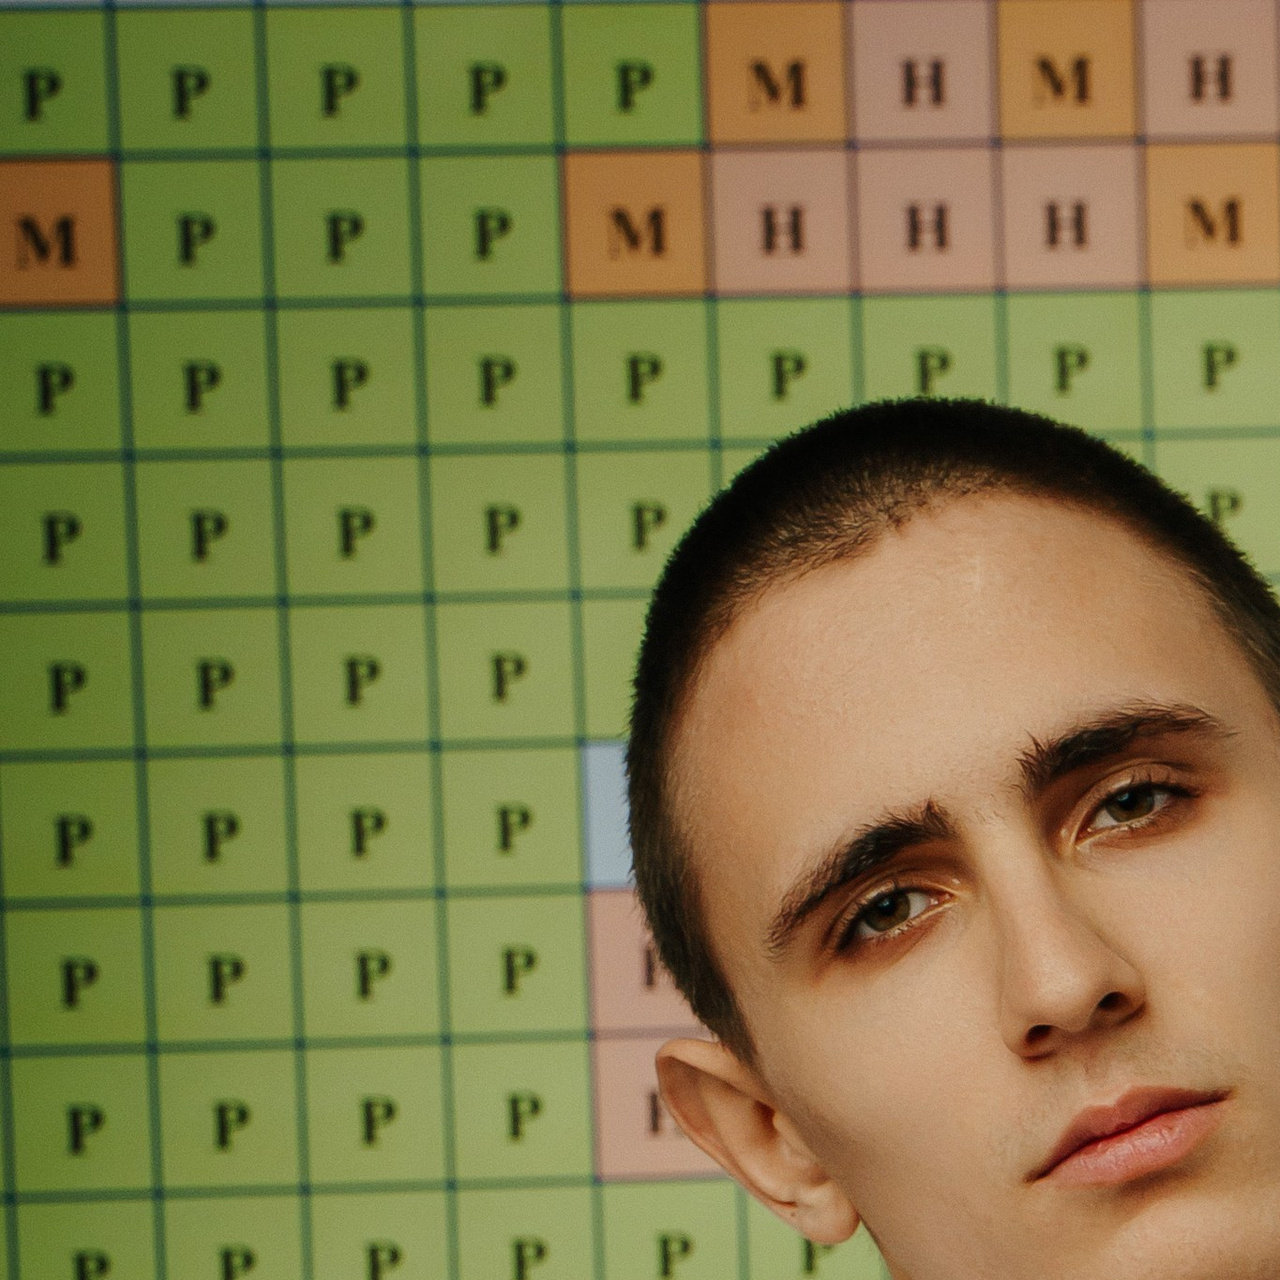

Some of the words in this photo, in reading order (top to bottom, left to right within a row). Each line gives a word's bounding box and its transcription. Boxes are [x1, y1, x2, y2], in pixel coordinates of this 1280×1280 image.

[21, 66, 64, 124] Р
[170, 65, 212, 121] Р
[467, 61, 509, 117] Р
[615, 59, 655, 114] Р
[749, 58, 807, 111] М
[901, 58, 946, 108] Н
[1035, 54, 1091, 106] М
[1188, 53, 1233, 103] Н
[15, 214, 78, 270] М
[176, 212, 217, 268] Р
[324, 210, 366, 265] Р
[473, 207, 513, 263] Р
[609, 205, 667, 258] М
[760, 205, 805, 255] Н
[905, 203, 949, 252] Н
[1044, 200, 1088, 249] Н
[1185, 195, 1243, 248] М
[34, 362, 76, 418] Р
[182, 360, 223, 415] Р
[330, 357, 371, 412] Р
[625, 352, 664, 405] Р
[770, 350, 808, 402] Р
[915, 348, 952, 394] Р
[1202, 343, 1238, 391] Р
[41, 511, 83, 568] Р
[189, 509, 230, 564] Р
[336, 507, 376, 560] Р
[630, 501, 668, 552] Р
[195, 658, 236, 712] Р
[343, 655, 382, 708] Р
[490, 652, 528, 703] Р
[201, 810, 241, 865] Р
[349, 807, 388, 859] Р
[496, 804, 533, 855] Р
[207, 954, 246, 1007] Р
[355, 950, 393, 1001] Р
[501, 946, 538, 997] Р
[65, 1104, 106, 1158] Р
[212, 1100, 252, 1152] Р
[506, 1093, 543, 1142] Р
